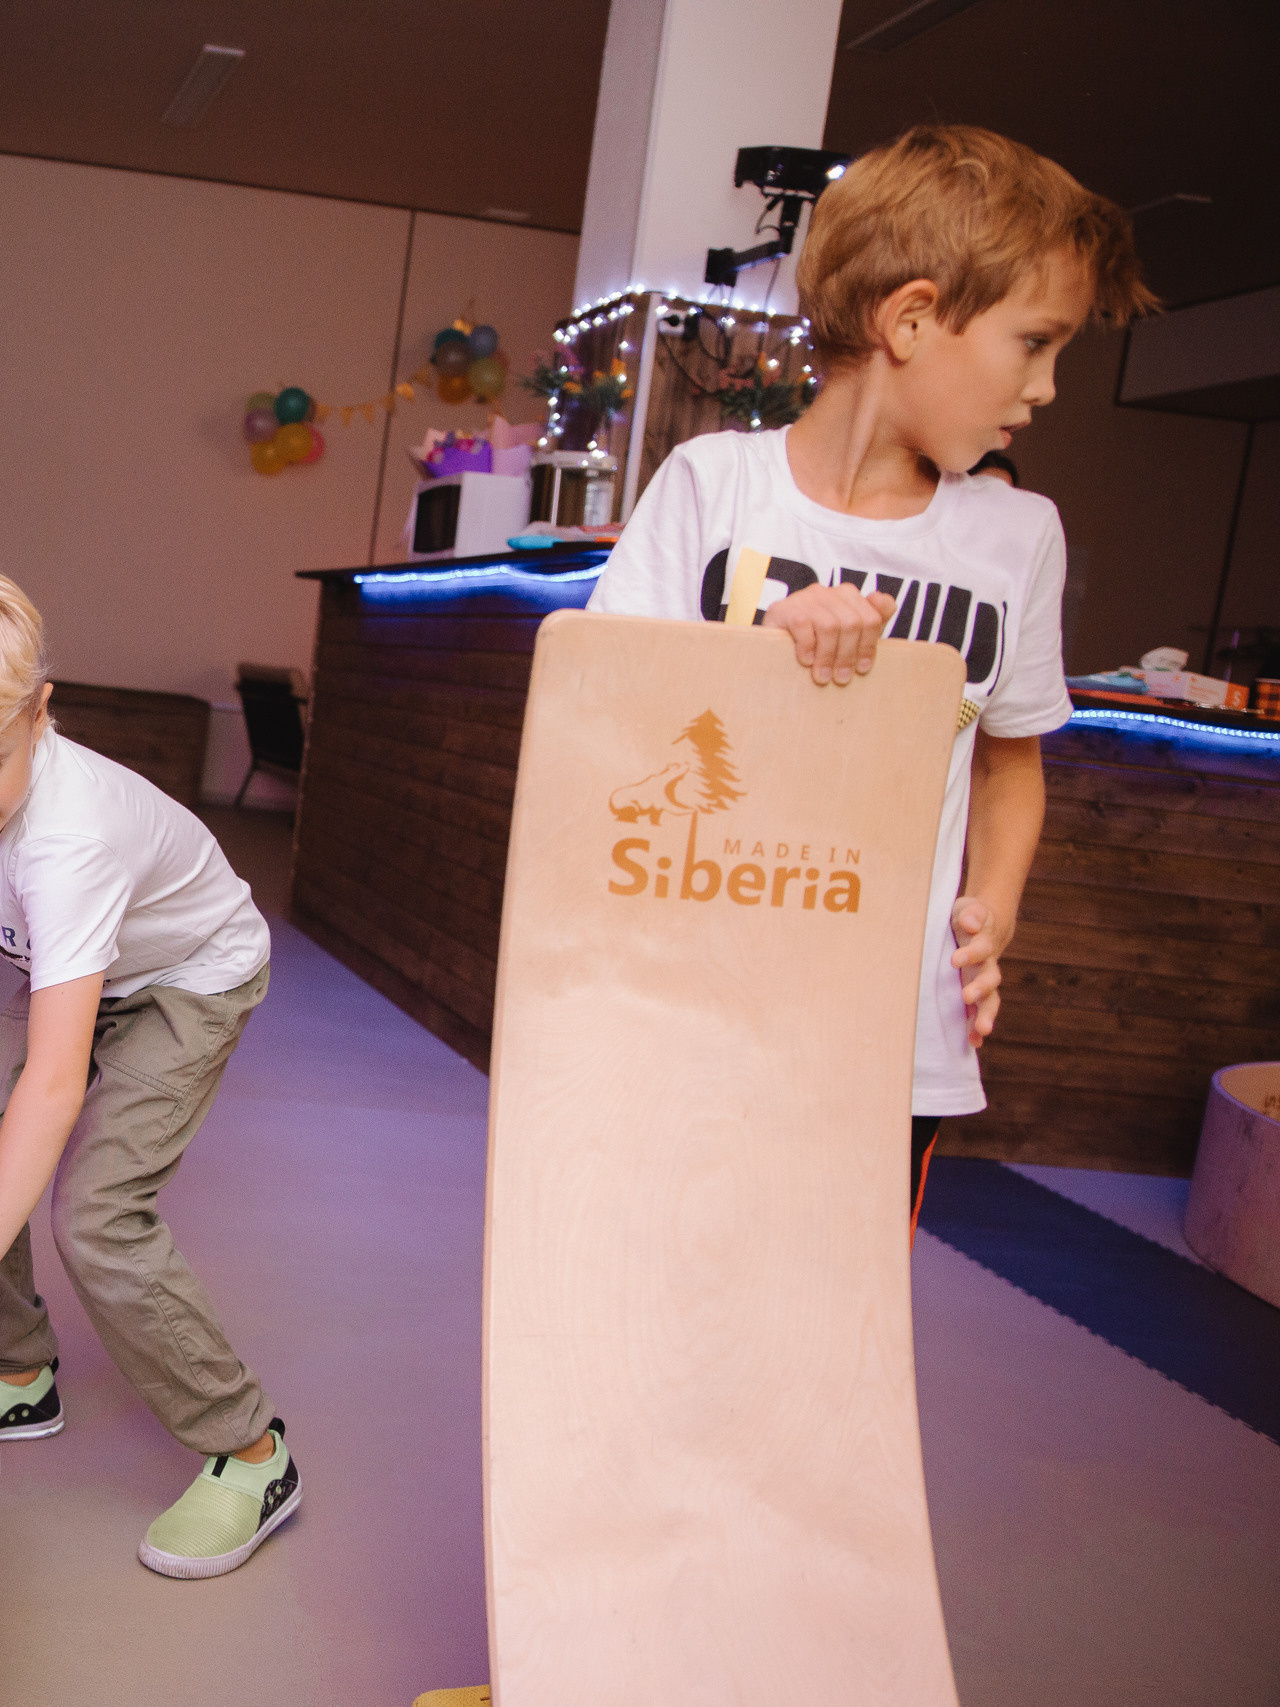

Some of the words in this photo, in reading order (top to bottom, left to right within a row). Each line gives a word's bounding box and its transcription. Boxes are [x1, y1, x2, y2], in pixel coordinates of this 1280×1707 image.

[607, 810, 862, 914] Siberia
[723, 838, 811, 861] MADE
[829, 847, 862, 864] IN
